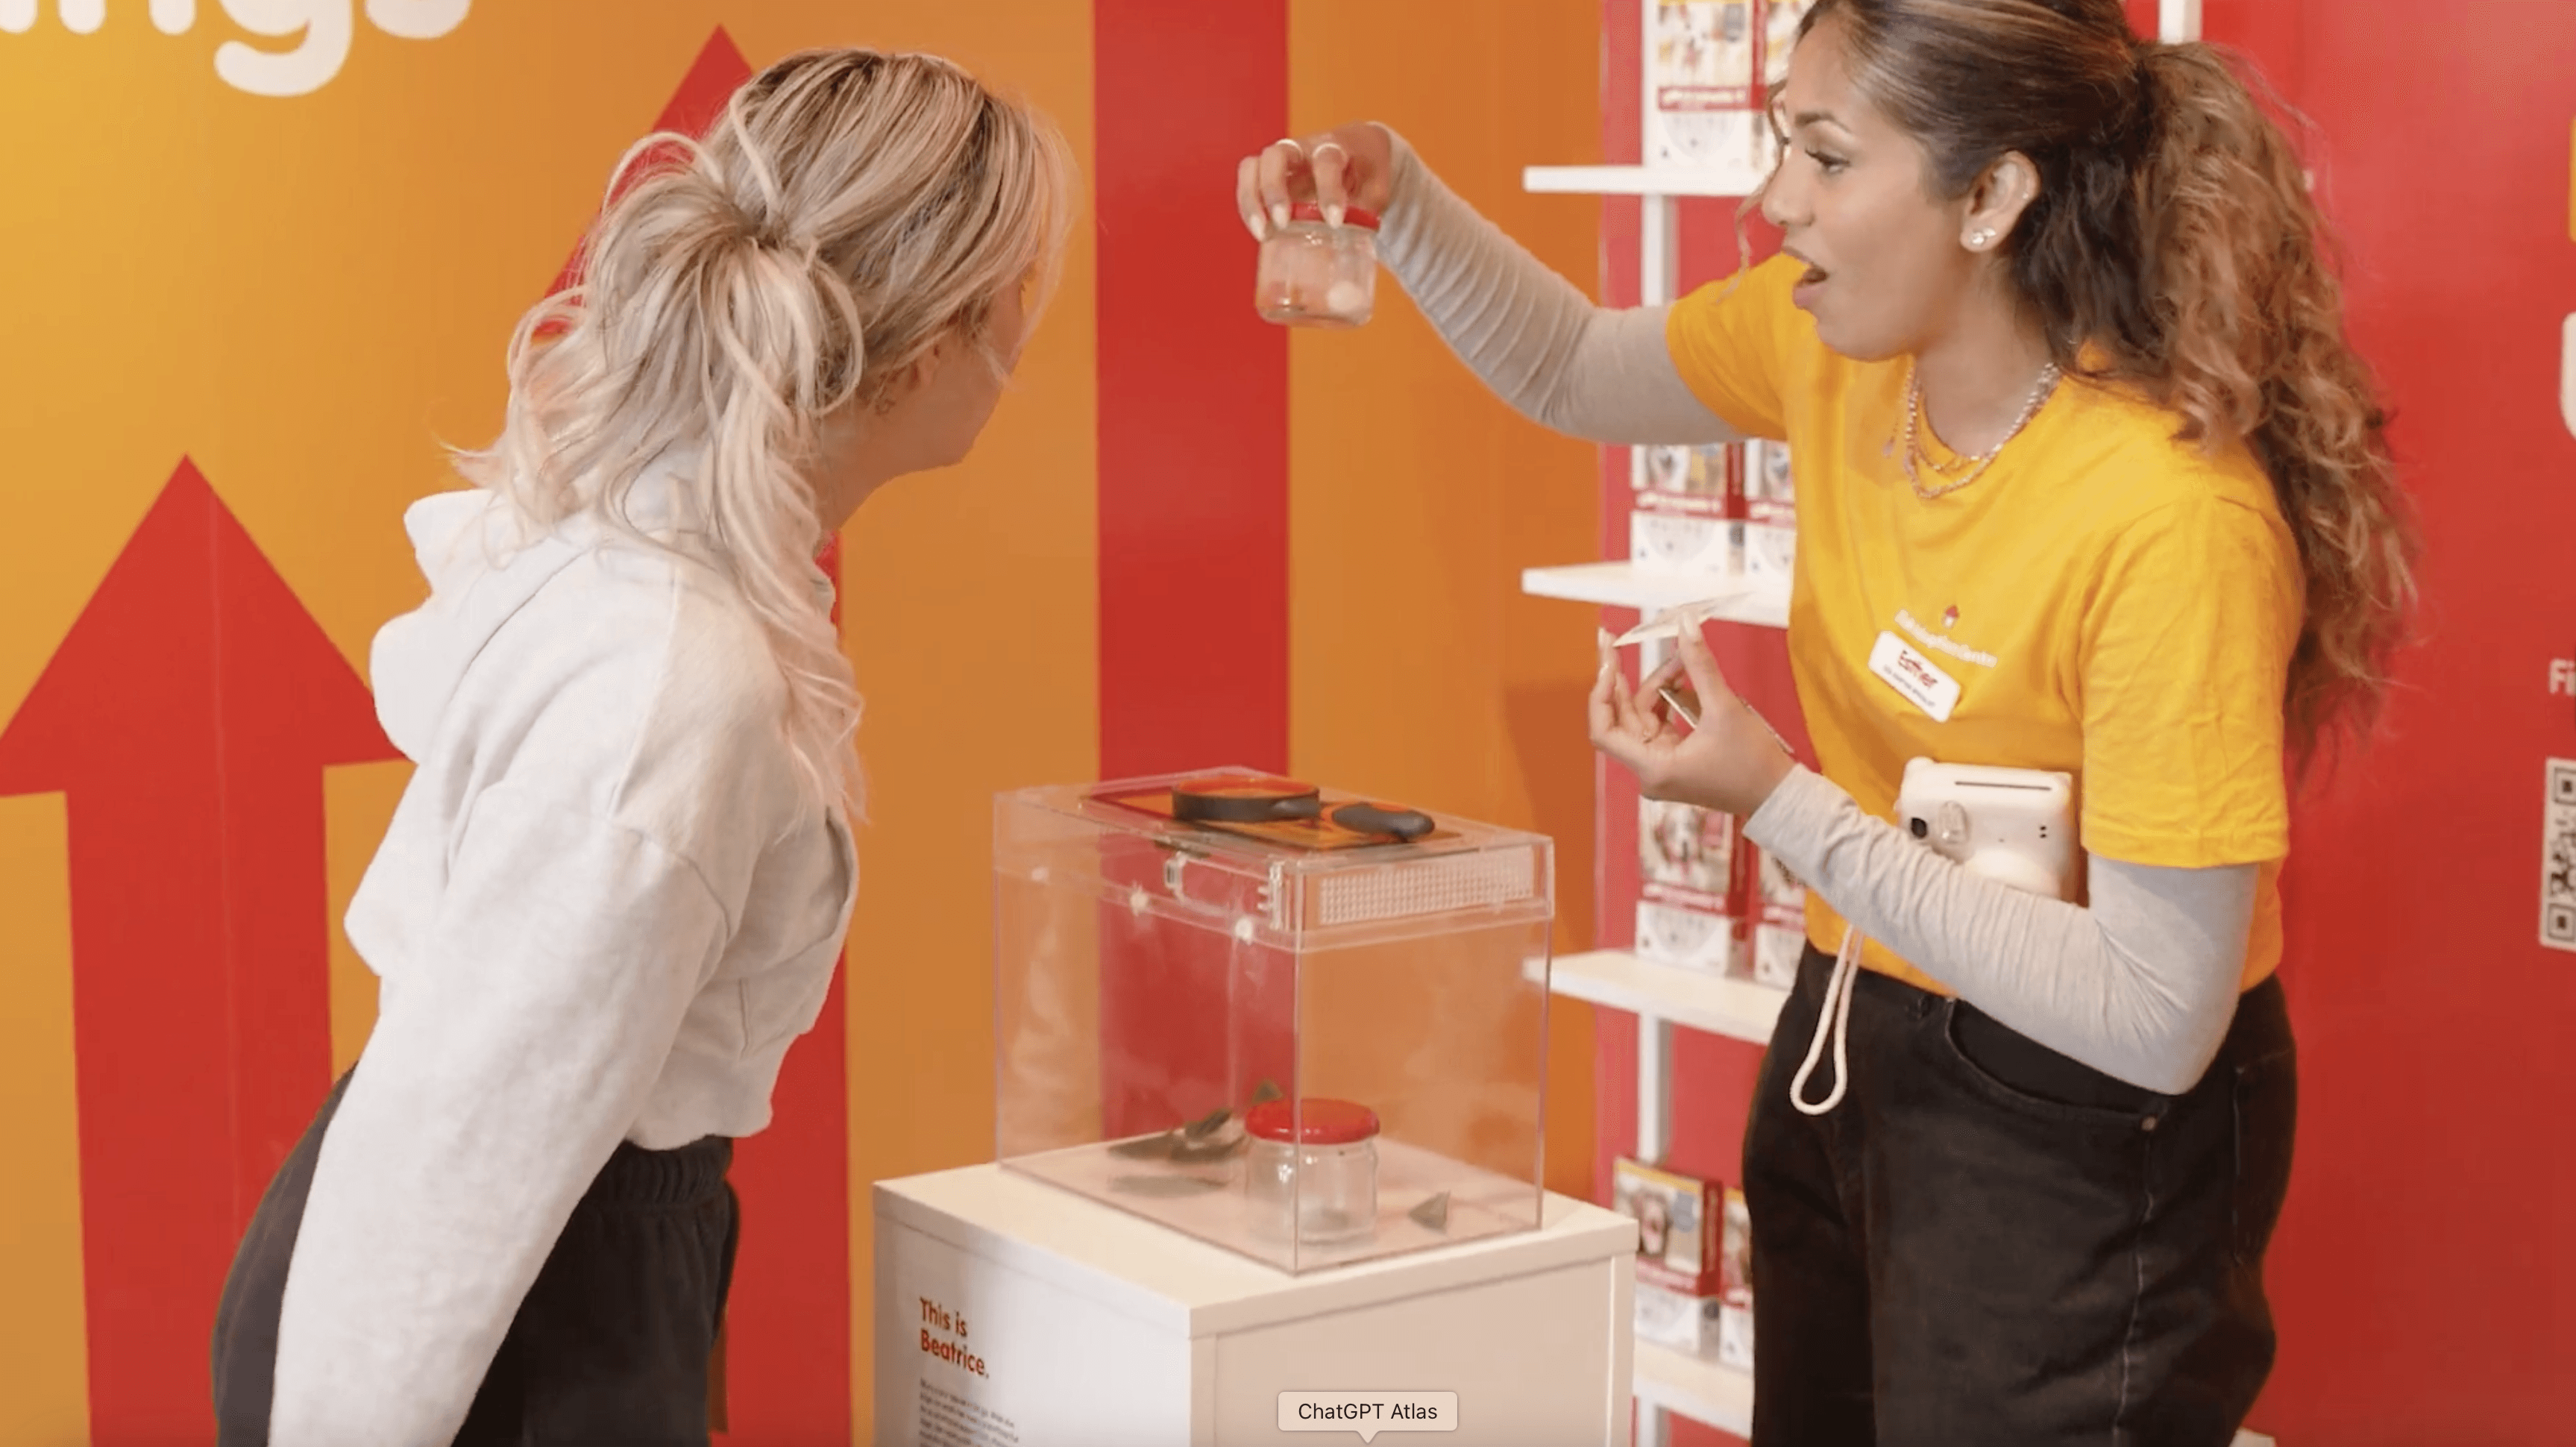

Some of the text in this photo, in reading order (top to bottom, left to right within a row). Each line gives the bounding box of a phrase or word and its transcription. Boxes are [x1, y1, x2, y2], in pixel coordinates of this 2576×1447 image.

[920, 1297, 967, 1337] This is
[921, 1329, 989, 1379] Beatrice.
